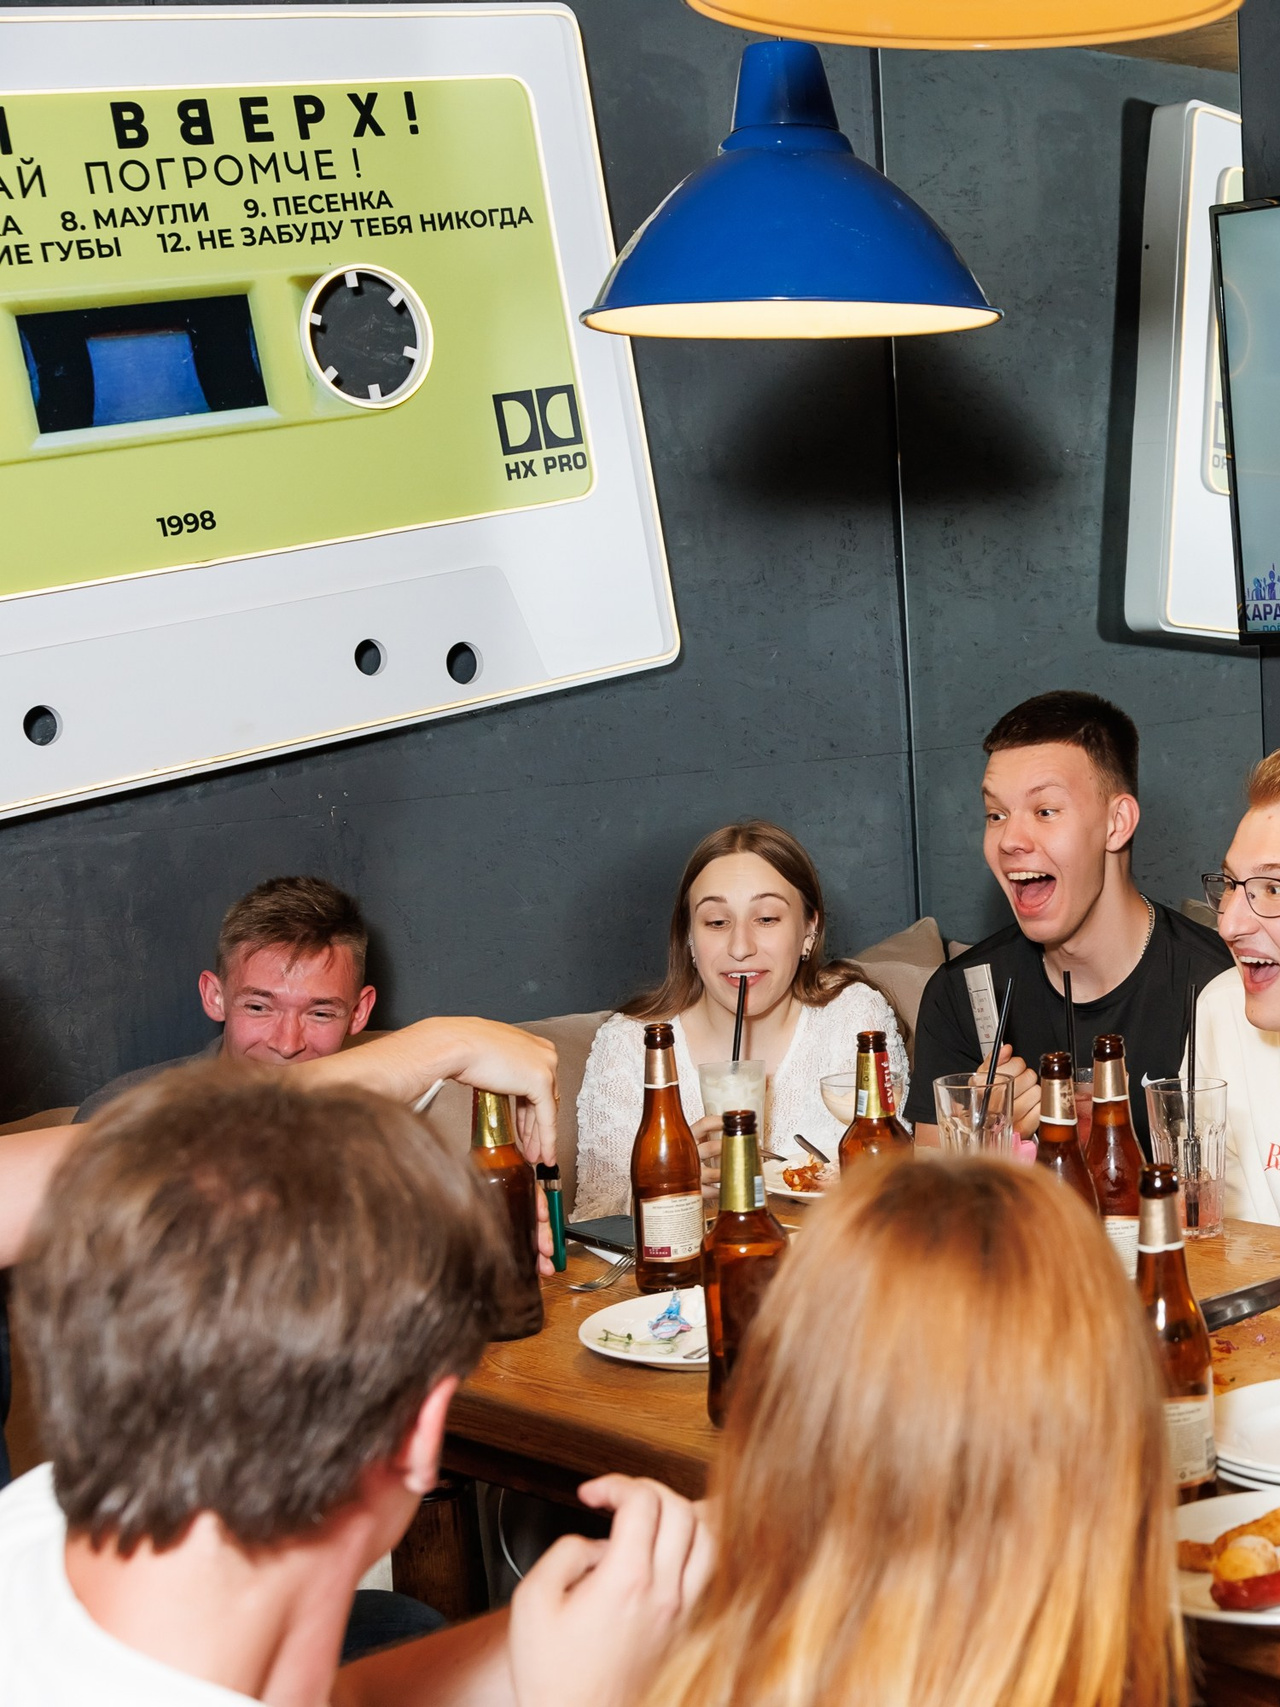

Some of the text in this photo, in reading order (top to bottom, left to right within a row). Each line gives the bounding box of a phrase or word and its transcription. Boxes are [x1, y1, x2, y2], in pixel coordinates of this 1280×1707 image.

[59, 210, 87, 232] 8.
[92, 201, 210, 230] МАУГЛИ
[243, 198, 268, 219] 9.
[272, 189, 394, 217] ПЕСЕНКА
[40, 236, 123, 263] ГУБЫ
[156, 231, 192, 254] 12.
[197, 228, 235, 251] НЕ
[240, 219, 344, 248] ЗАБУДУ
[350, 214, 413, 238] ТЕБЯ
[418, 205, 534, 233] НИКОГДА
[504, 450, 588, 482] HX PRO
[155, 508, 217, 538] 1998
